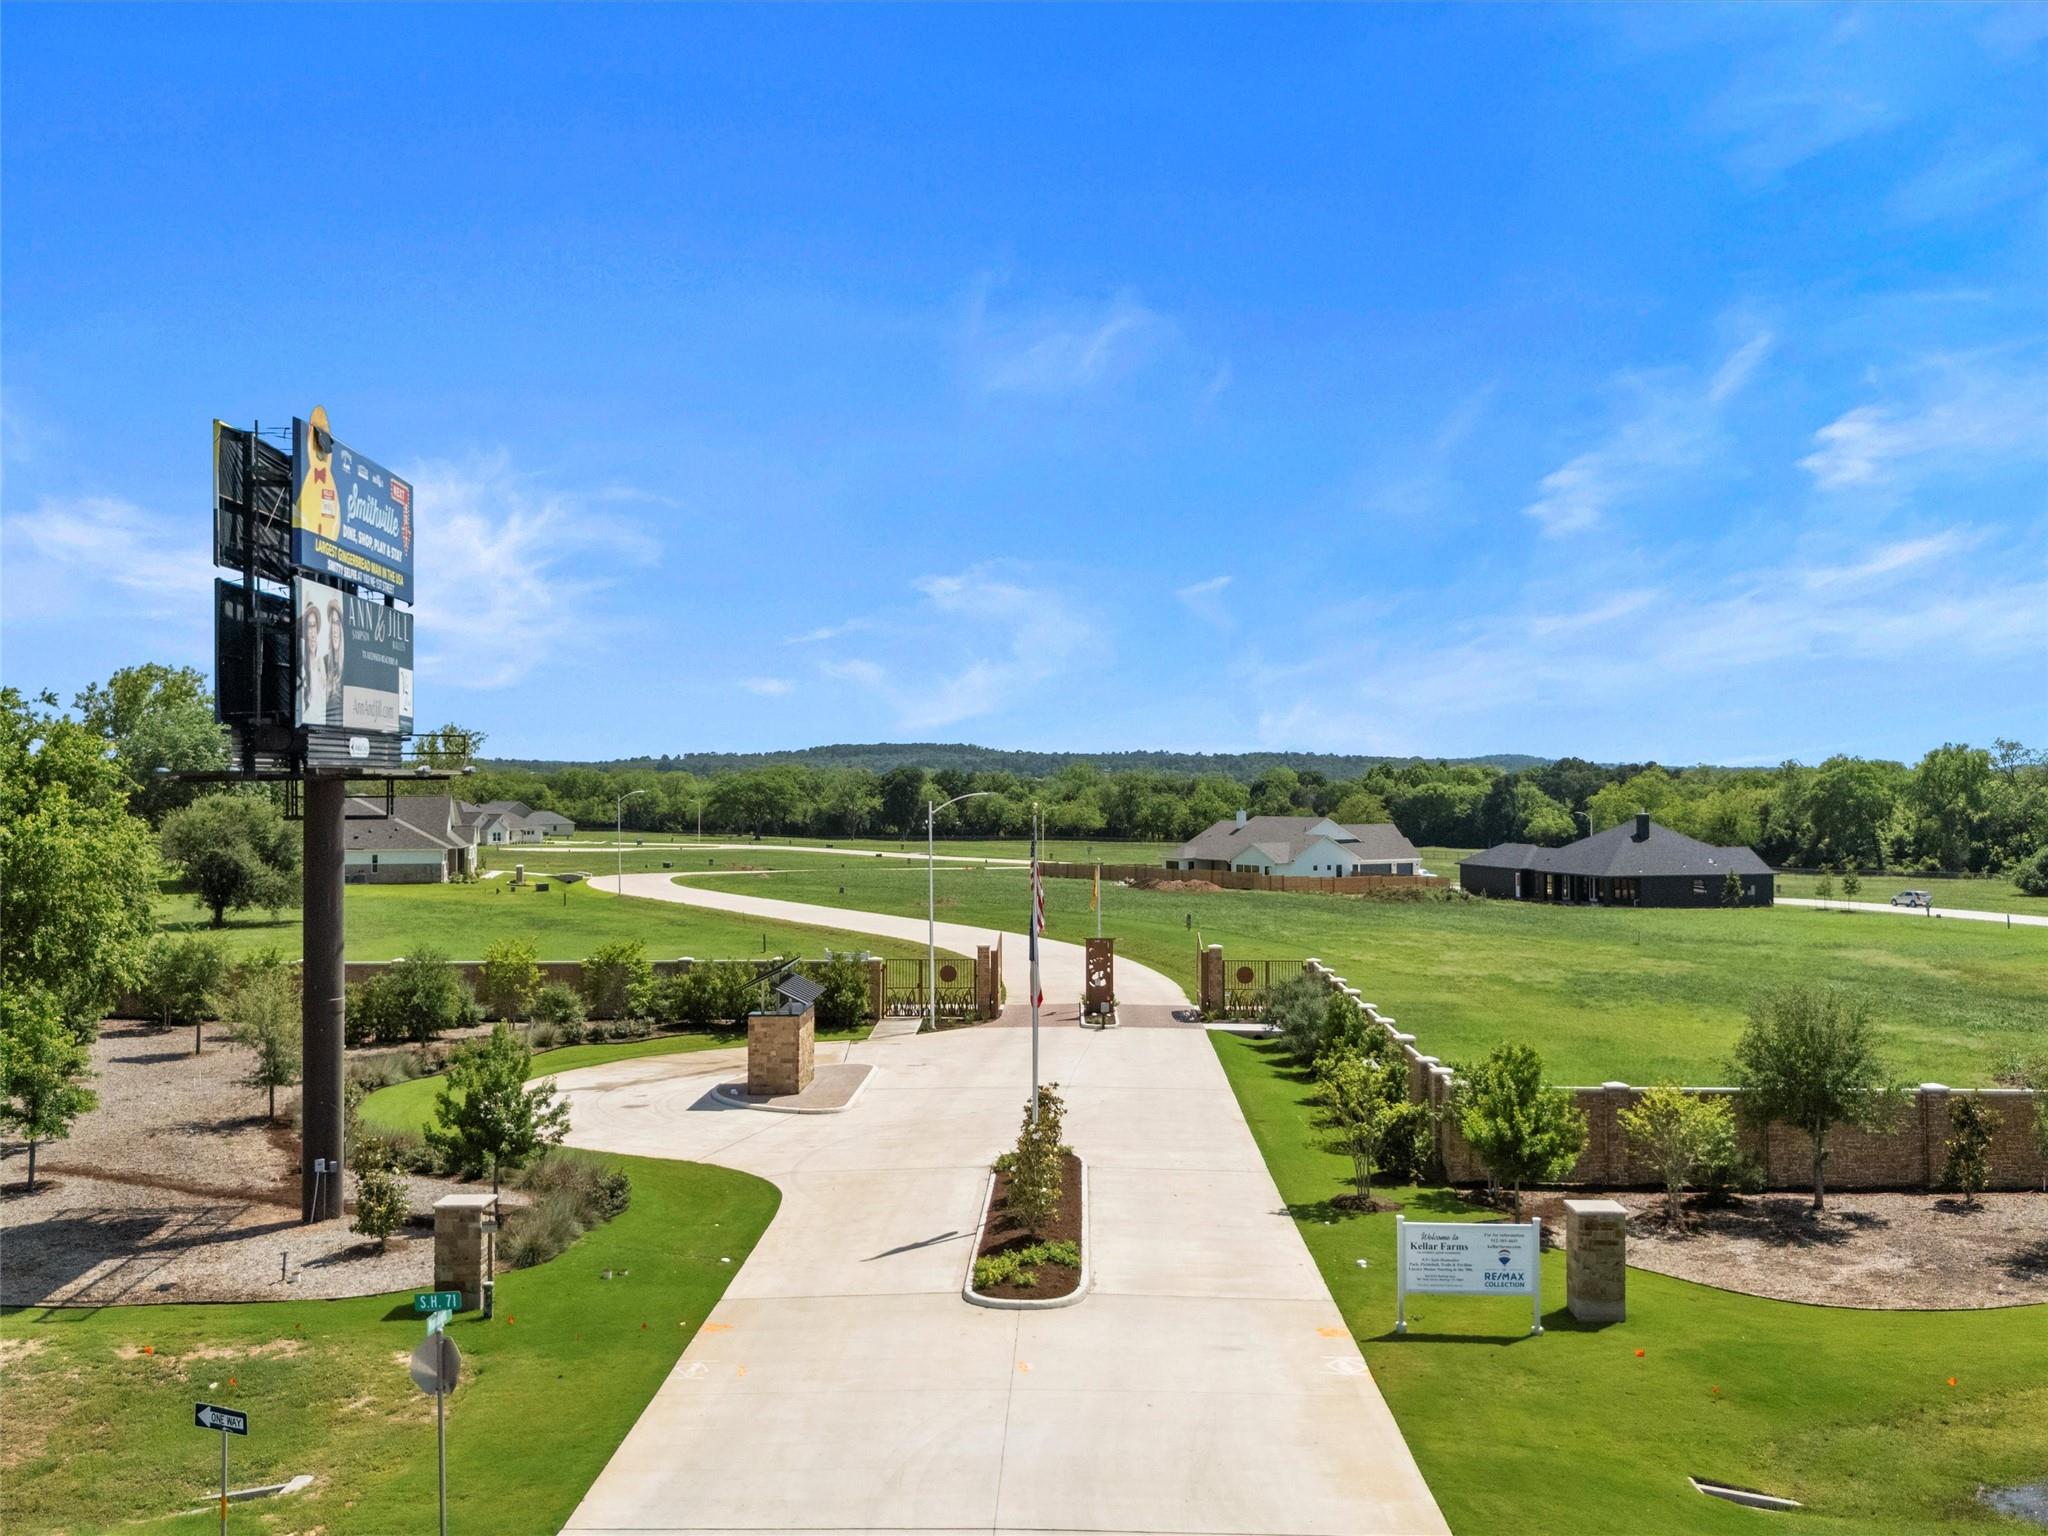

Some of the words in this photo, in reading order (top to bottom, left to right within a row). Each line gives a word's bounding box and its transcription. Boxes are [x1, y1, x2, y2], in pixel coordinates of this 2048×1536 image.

[347, 483, 399, 537] Smithville
[343, 524, 358, 544] DINE,
[358, 531, 373, 552] SHOP,
[373, 538, 386, 555] PLAY
[391, 547, 402, 562] STAY
[315, 538, 338, 559] LARGEST
[338, 548, 371, 572] GINGERBREAD
[371, 561, 382, 576] MAN
[349, 597, 373, 631] ANN
[375, 604, 385, 642] &
[388, 609, 409, 642] JILL
[1421, 1231, 1450, 1241] Welcome
[1452, 1233, 1459, 1241] to
[1410, 1242, 1438, 1250] Kellar
[1440, 1242, 1469, 1251] Farms
[1484, 1272, 1524, 1280] RE/MAX
[420, 1295, 441, 1308] S.H.
[445, 1294, 457, 1307] 71
[211, 1412, 225, 1425] ONE
[226, 1416, 242, 1428] WAY
